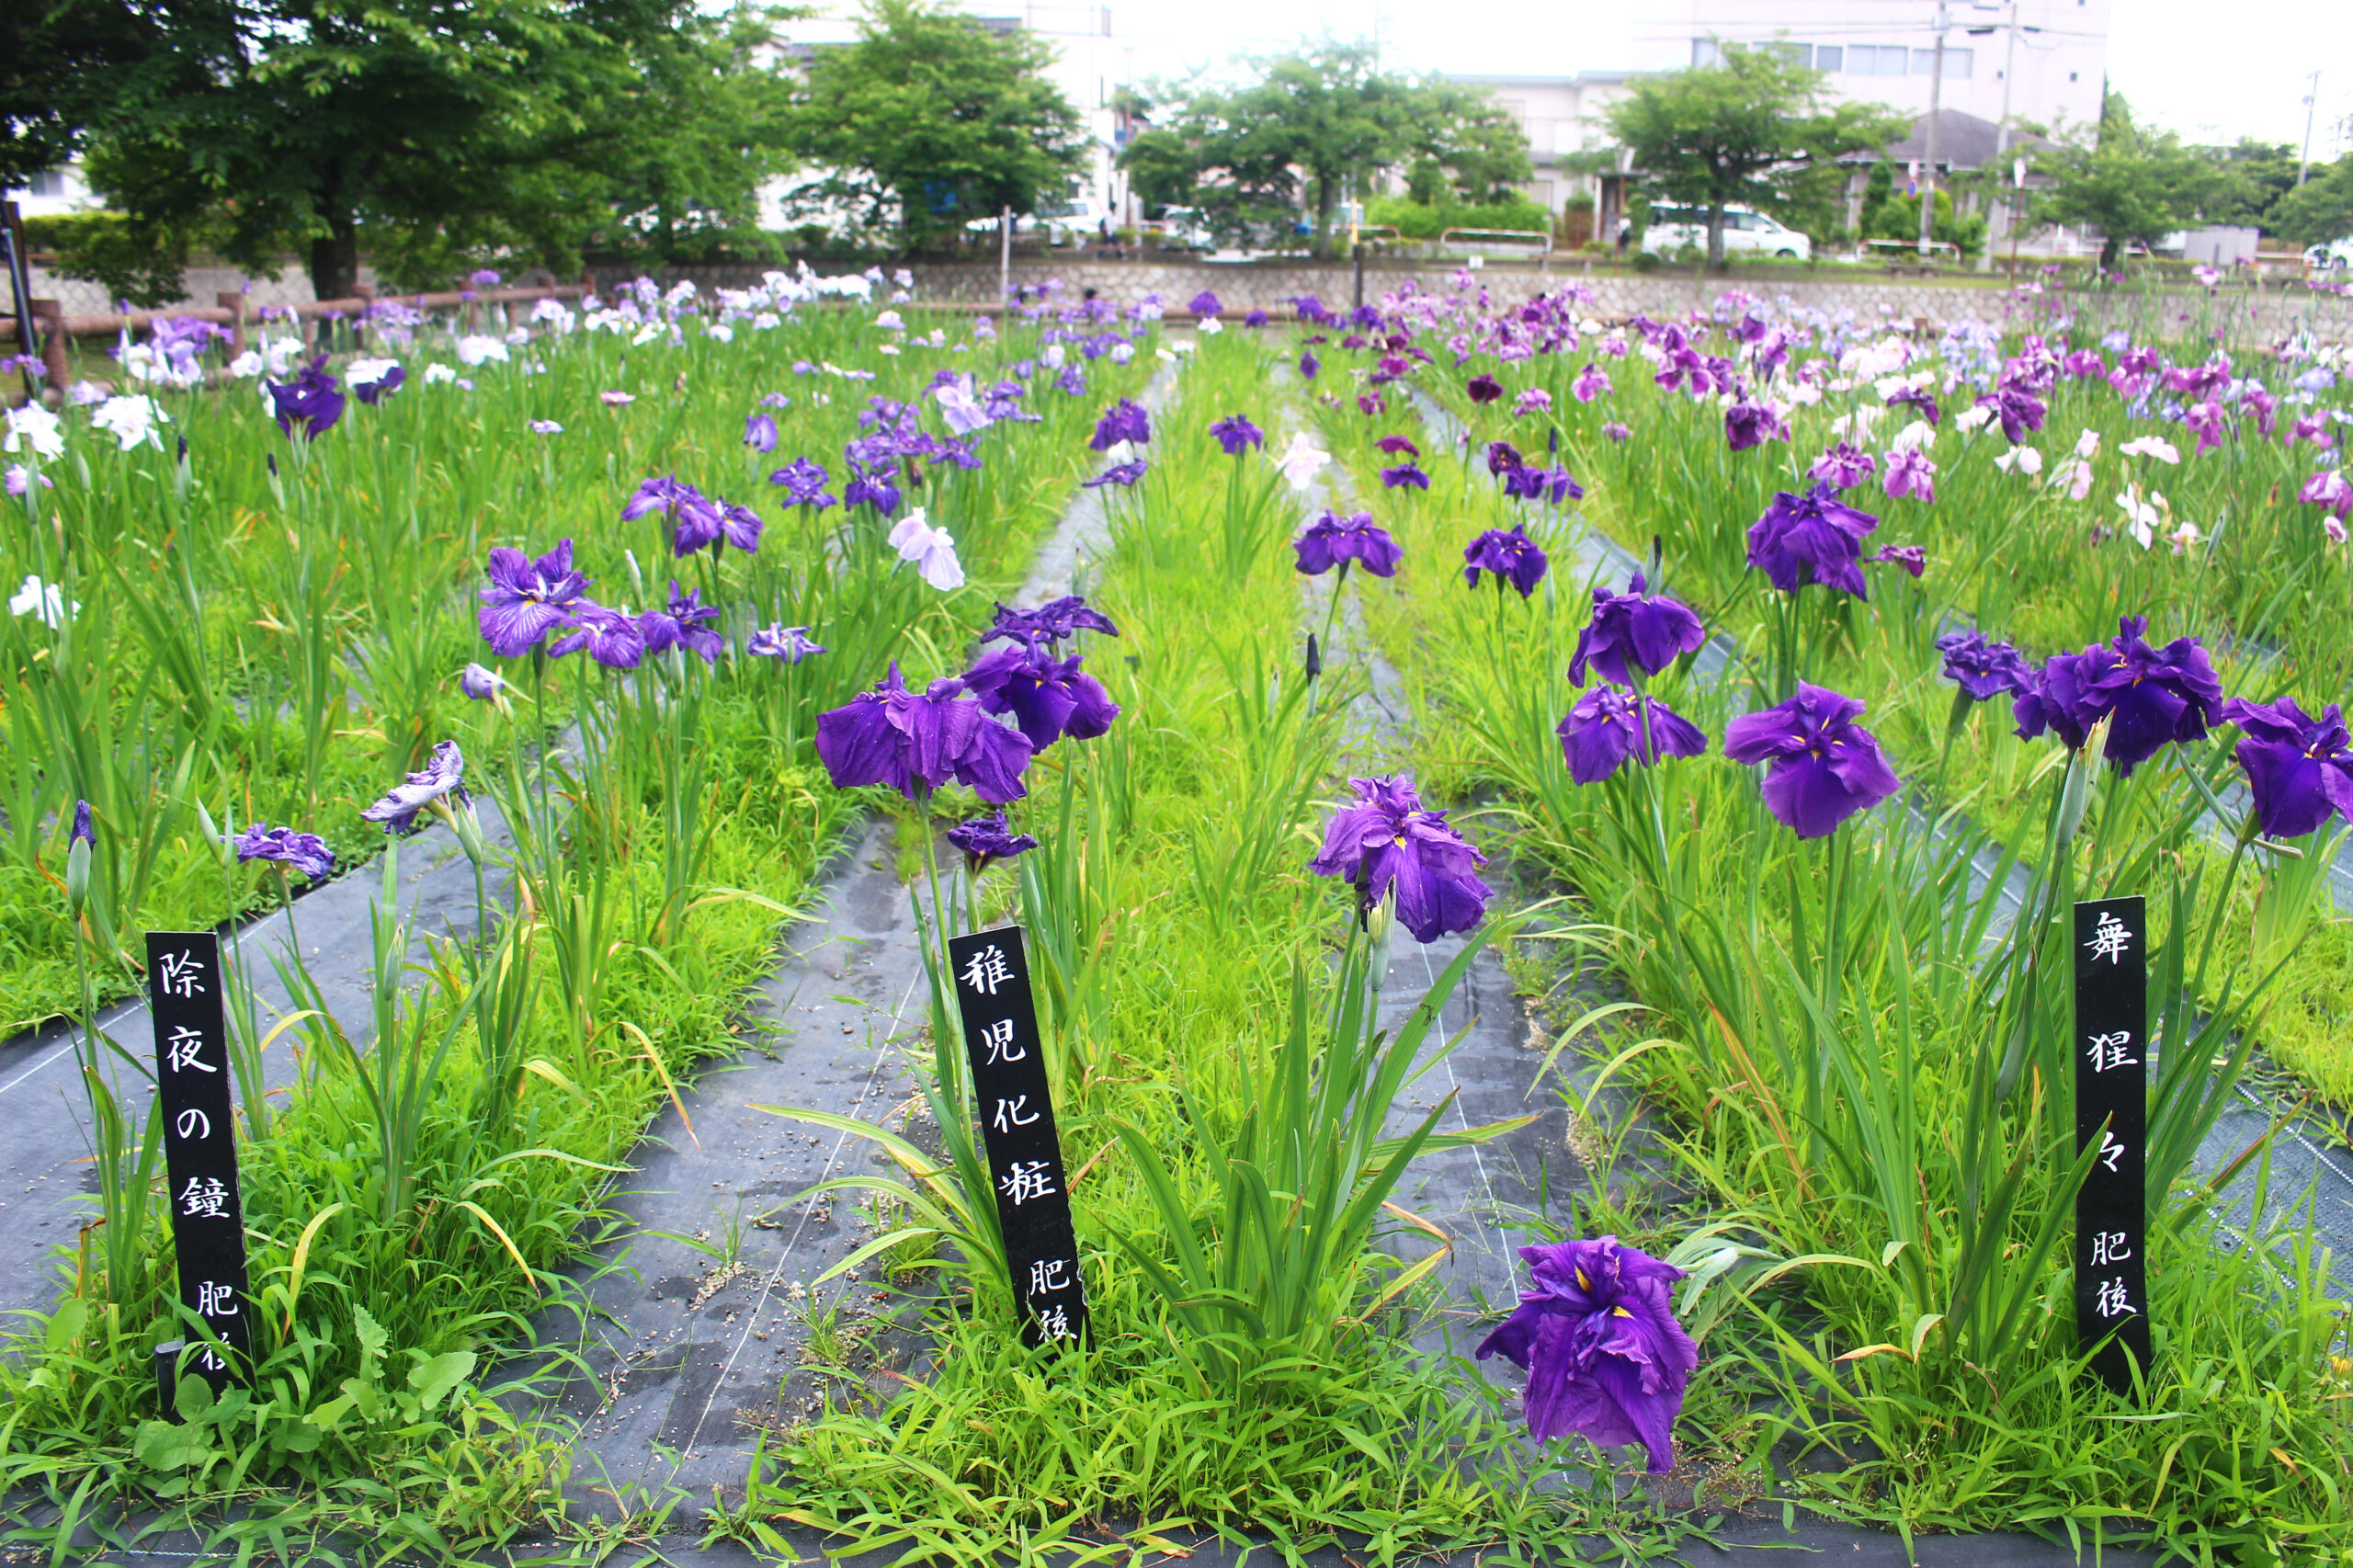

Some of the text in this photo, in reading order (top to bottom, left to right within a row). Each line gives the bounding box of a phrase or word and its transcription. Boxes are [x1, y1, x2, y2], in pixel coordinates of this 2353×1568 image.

[159, 949, 230, 1218] 除夜の鐘
[959, 944, 1078, 1343] 稚児化粧 肥後
[2090, 1232, 2137, 1318] 肥後
